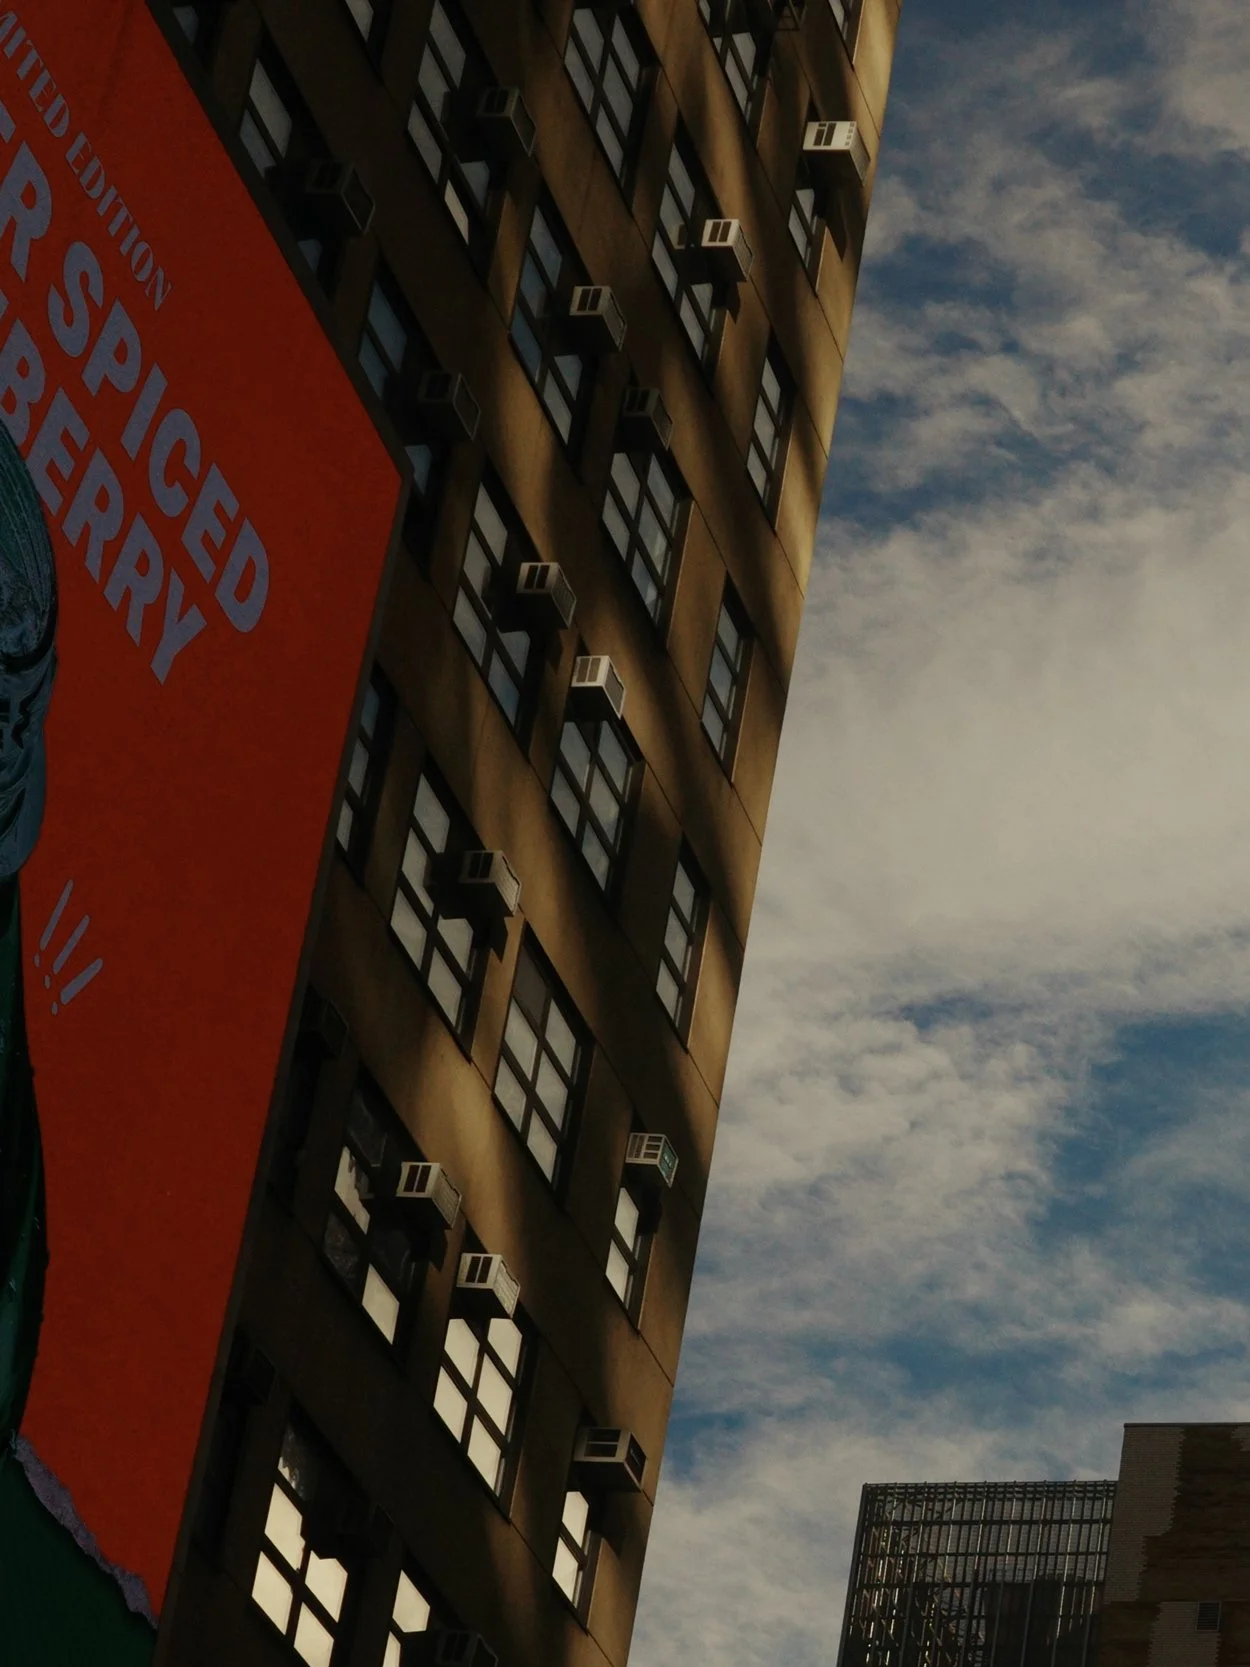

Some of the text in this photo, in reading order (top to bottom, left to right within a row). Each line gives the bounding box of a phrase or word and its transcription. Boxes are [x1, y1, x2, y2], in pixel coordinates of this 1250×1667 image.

[0, 102, 270, 633] R SPICED
[65, 131, 174, 311] EDITION
[0, 288, 207, 686] BERRY
